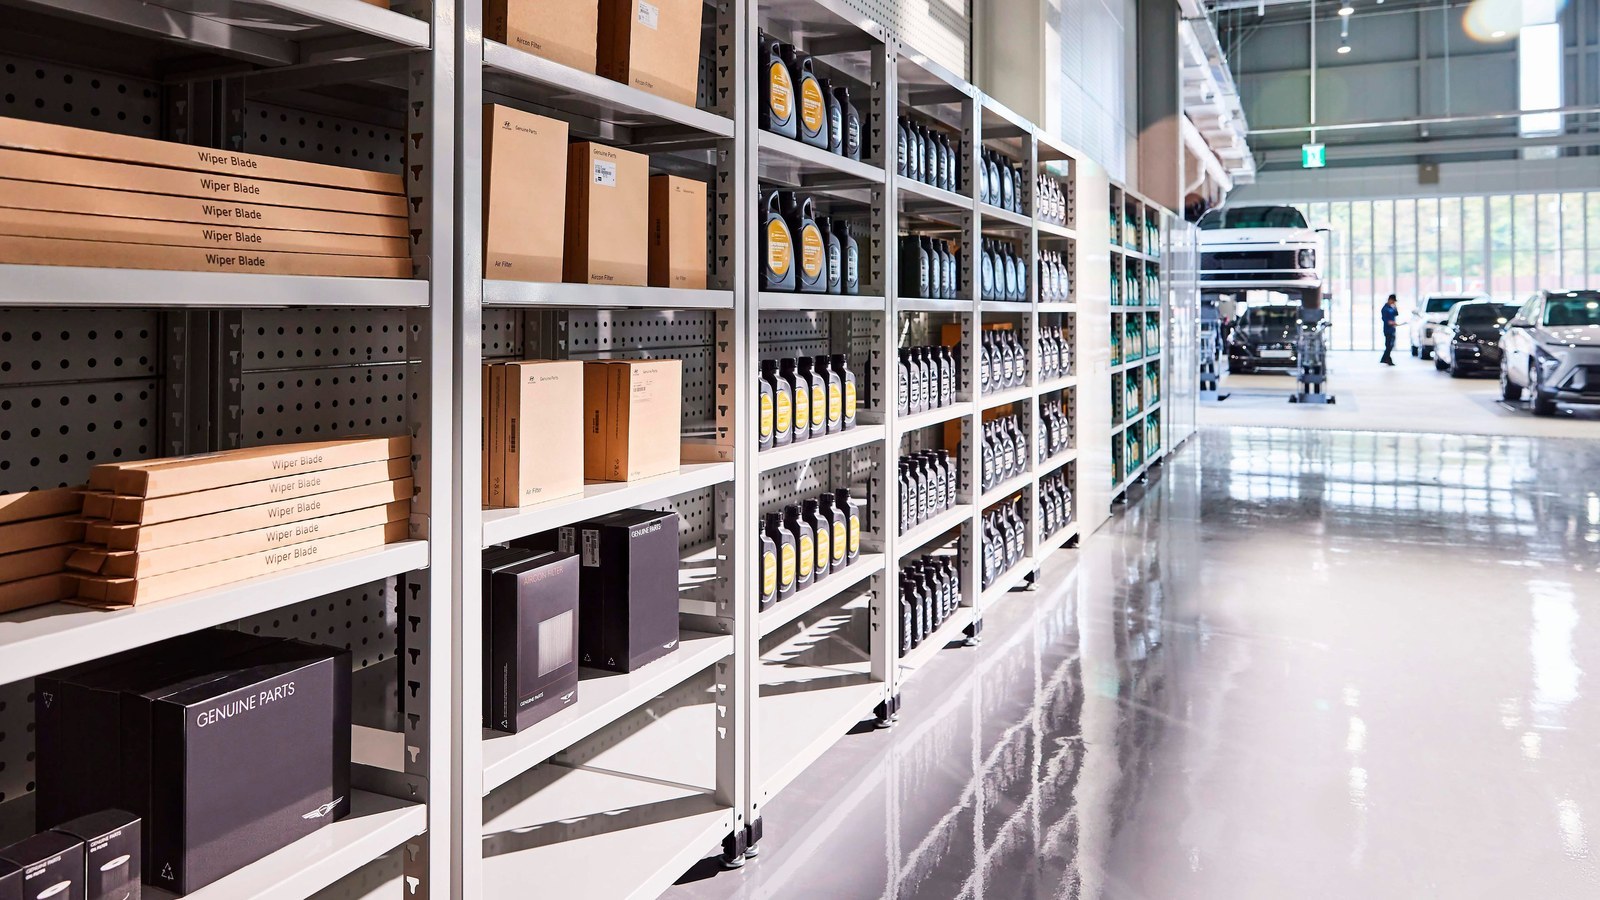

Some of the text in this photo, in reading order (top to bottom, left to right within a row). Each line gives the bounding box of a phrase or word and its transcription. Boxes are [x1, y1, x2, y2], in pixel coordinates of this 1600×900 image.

[516, 36, 542, 50] Aircon Filter
[198, 152, 257, 168] Wiper Blade
[593, 148, 608, 157] Genuine
[200, 178, 260, 194] Wiper Blade
[202, 205, 262, 219] Wiper Blade
[202, 230, 262, 243] Wiper Blade
[206, 254, 265, 266] Wiper Blade
[272, 454, 322, 470] Wiper Blade
[270, 477, 321, 494] Wiper Blade
[268, 501, 320, 518] Wiper Blade
[266, 524, 318, 542] Wiper Blade
[631, 523, 662, 538] GENUINE PARTS
[264, 546, 318, 565] Wiper Blade
[523, 566, 564, 585] AIRCON FILTER
[196, 682, 296, 728] GENUINE PARTS
[520, 692, 544, 706] GENUINE PARTS
[90, 830, 122, 848] GENUINE PARTS
[25, 855, 61, 874] GENUINE PARTS
